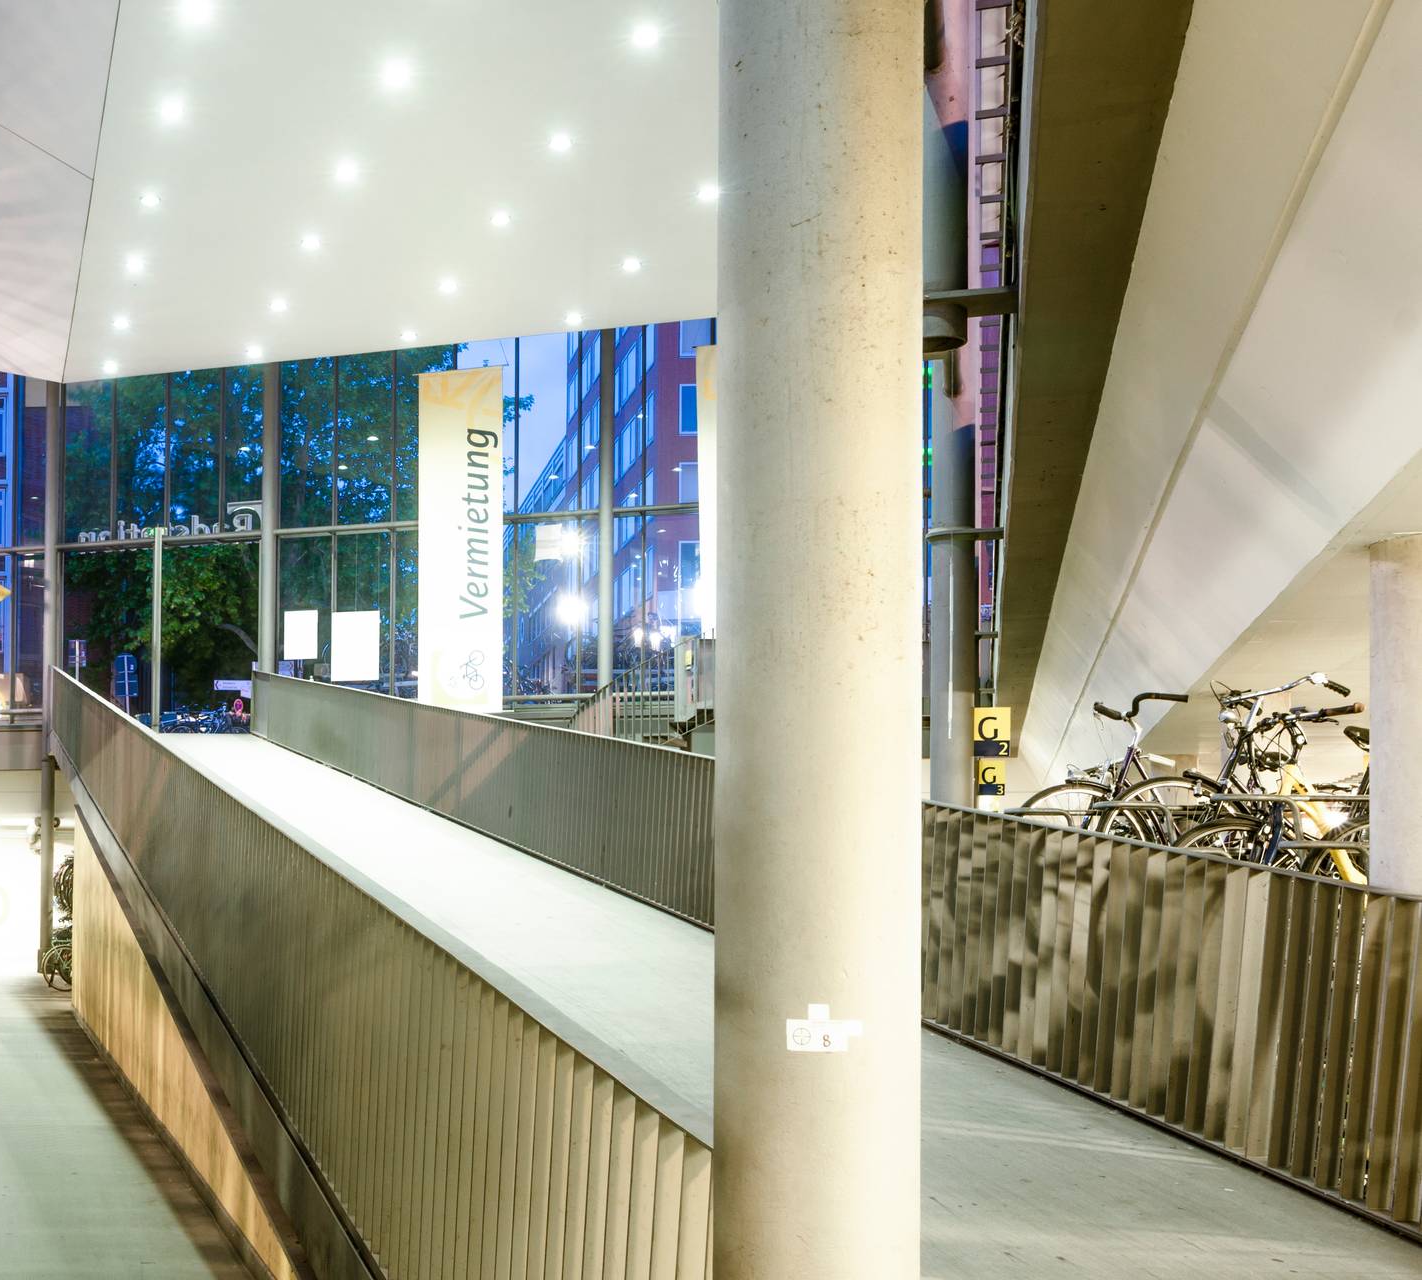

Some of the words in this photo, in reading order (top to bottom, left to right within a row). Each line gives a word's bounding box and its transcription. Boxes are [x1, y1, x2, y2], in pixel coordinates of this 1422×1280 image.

[458, 428, 498, 620] Vermietung
[978, 716, 998, 741] G
[998, 742, 1008, 756] 2
[981, 766, 996, 784] G
[996, 785, 1004, 795] 3
[822, 1034, 831, 1048] 8
